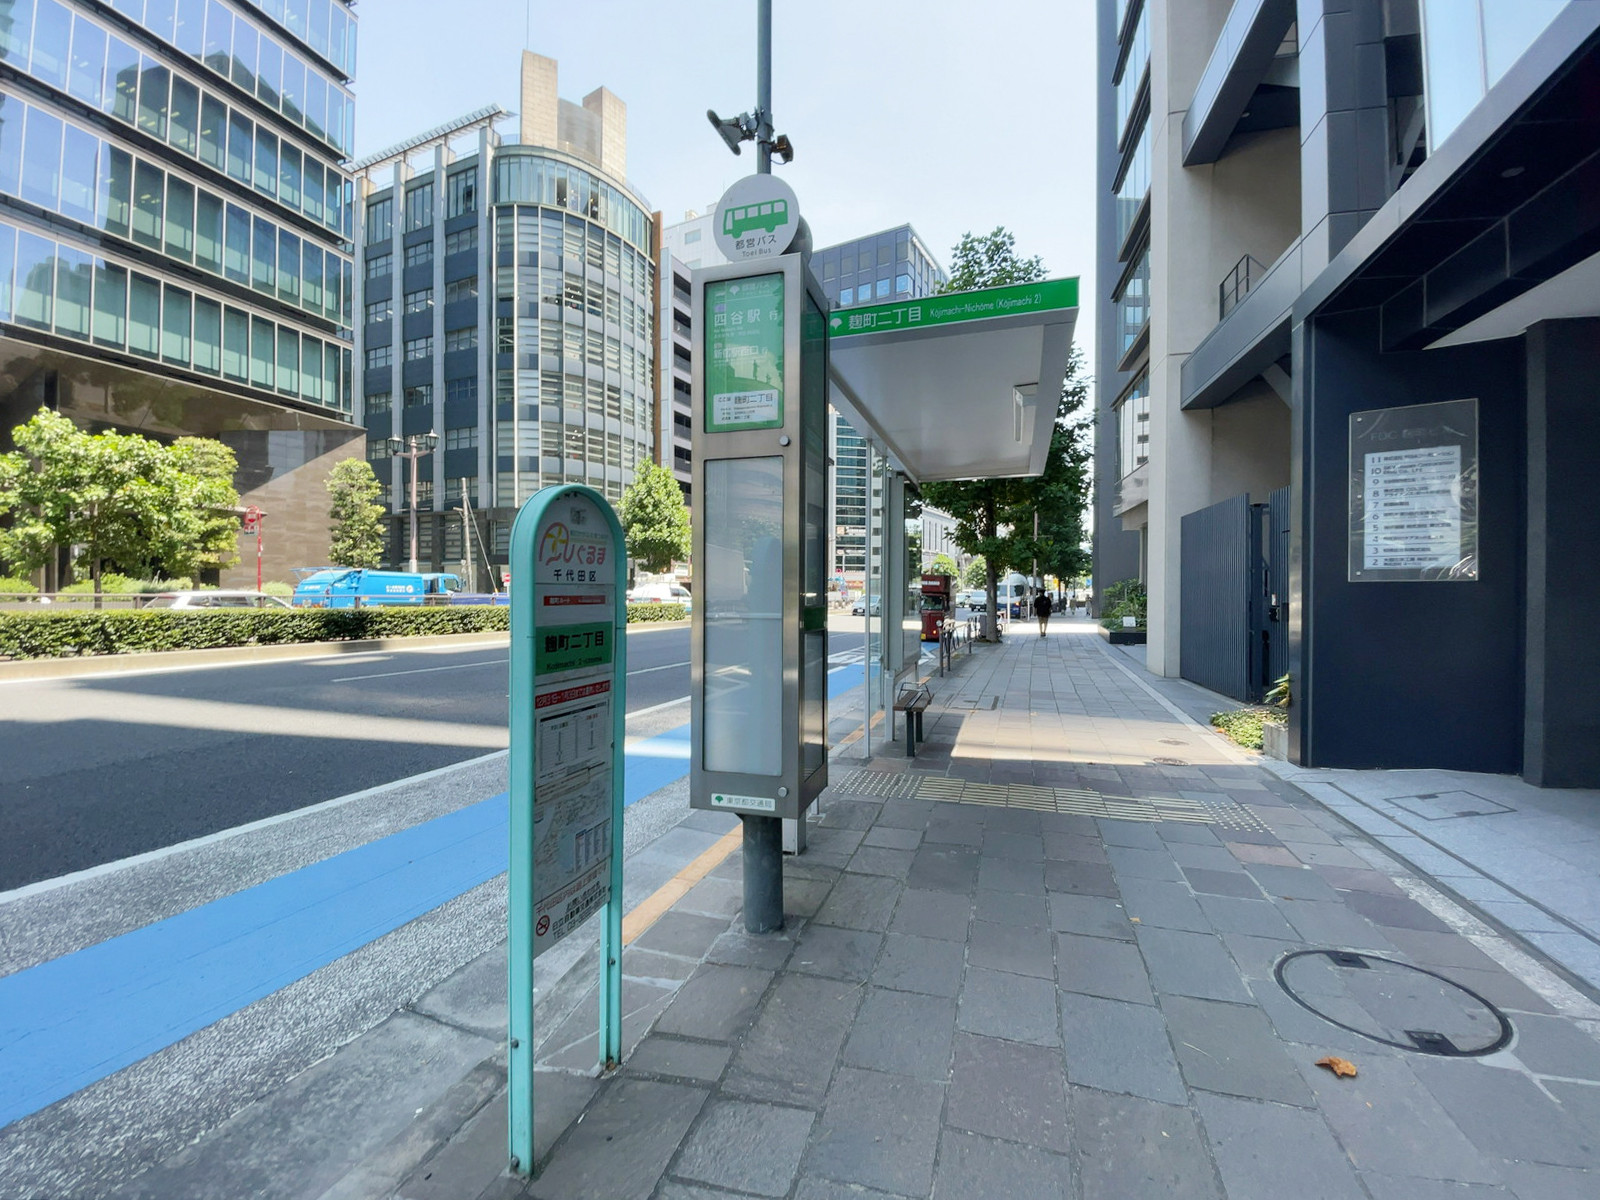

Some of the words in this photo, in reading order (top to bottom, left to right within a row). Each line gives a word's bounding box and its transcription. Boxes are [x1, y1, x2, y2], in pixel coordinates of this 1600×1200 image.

[735, 235, 777, 251] 都営バス
[742, 249, 758, 257] Toei
[759, 247, 771, 256] Bus
[1034, 294, 1042, 305] 2)
[714, 308, 761, 326] 四谷駅
[769, 310, 778, 321] 行
[1372, 558, 1379, 566] 2
[554, 569, 597, 582] 千代田区
[545, 630, 604, 653] 麹町二丁目
